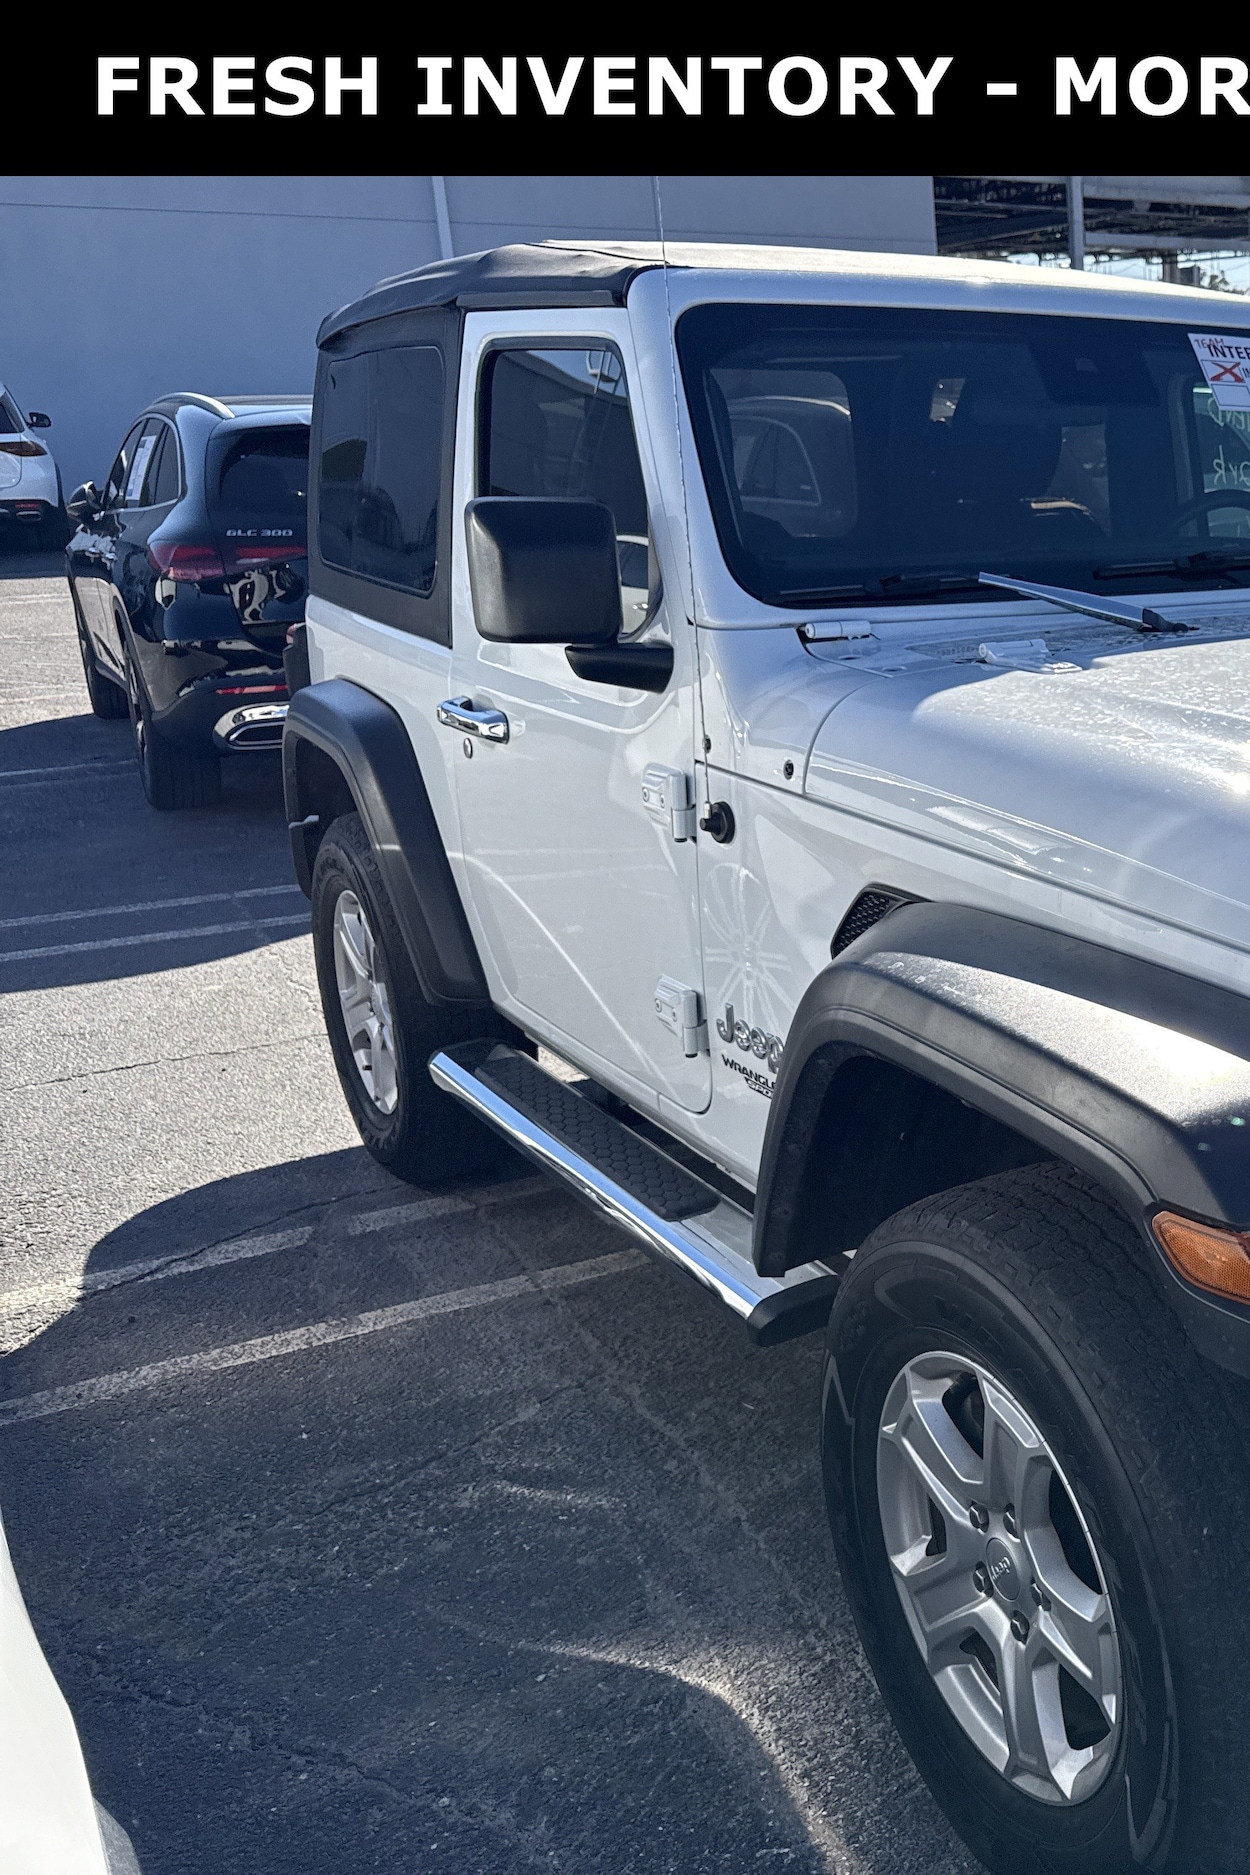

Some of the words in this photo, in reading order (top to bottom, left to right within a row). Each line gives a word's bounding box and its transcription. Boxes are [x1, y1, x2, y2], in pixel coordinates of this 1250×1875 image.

[226, 529, 258, 537] GLC
[260, 529, 293, 537] 300
[716, 1002, 785, 1074] Jeep
